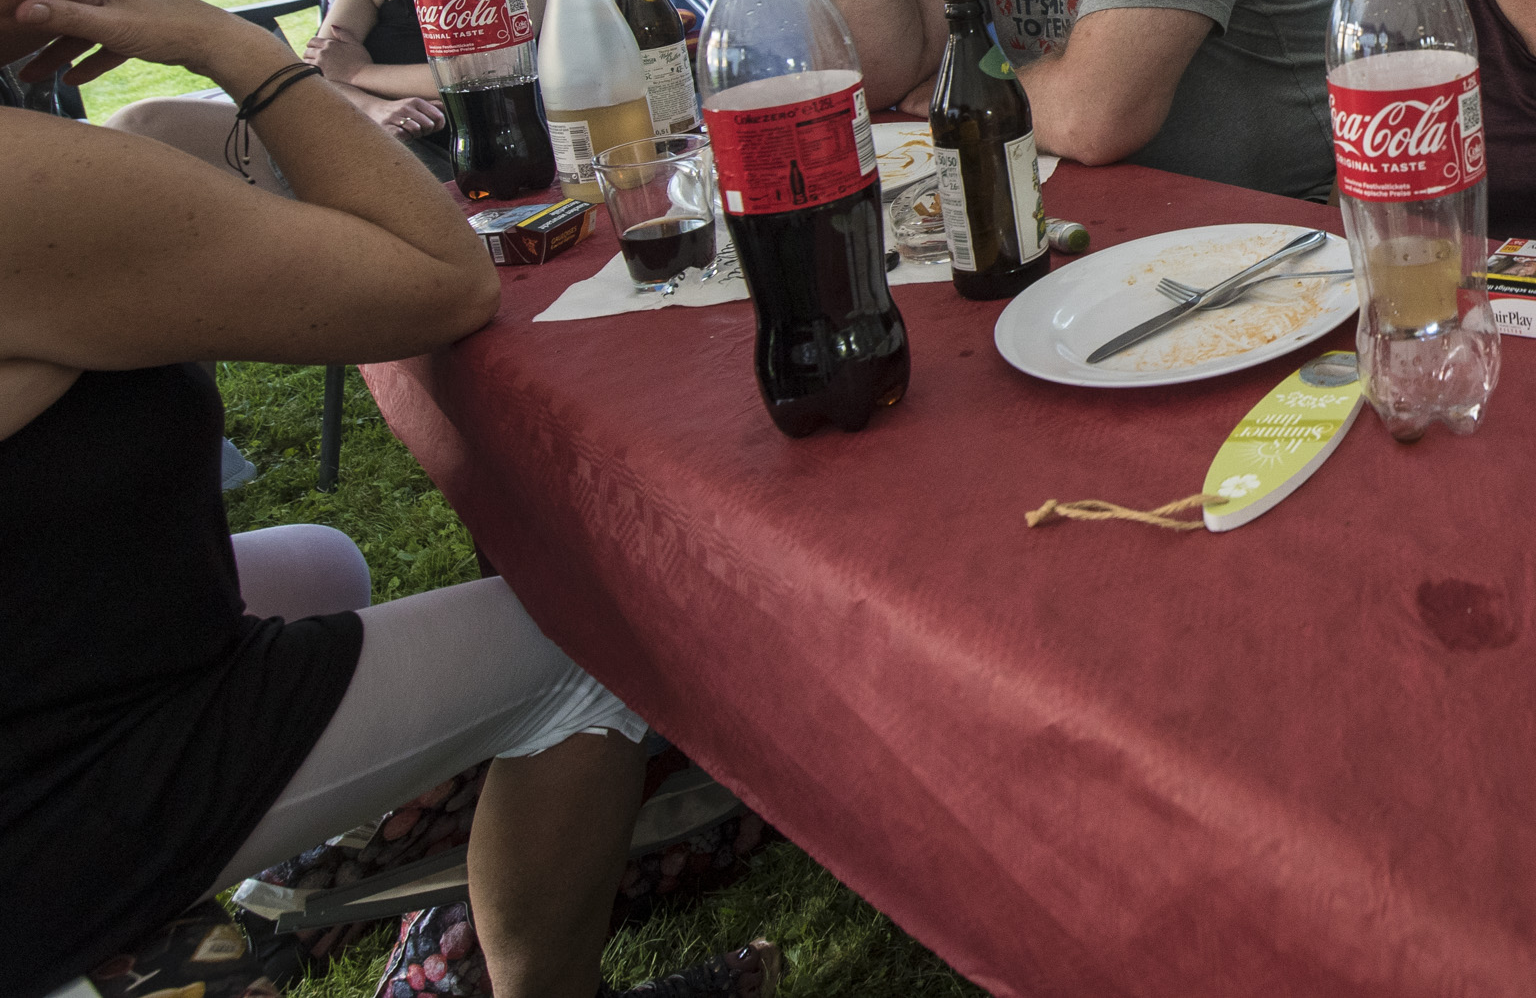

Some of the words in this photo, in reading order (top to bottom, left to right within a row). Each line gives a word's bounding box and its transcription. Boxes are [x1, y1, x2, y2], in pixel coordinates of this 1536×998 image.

[453, 29, 485, 38] TASTE
[1012, 16, 1042, 37] TO
[1381, 160, 1427, 174] TASTE
[1495, 285, 1528, 294] schädigt
[1255, 413, 1303, 425] time
[1235, 423, 1334, 441] Summer
[1273, 438, 1304, 454] It's
